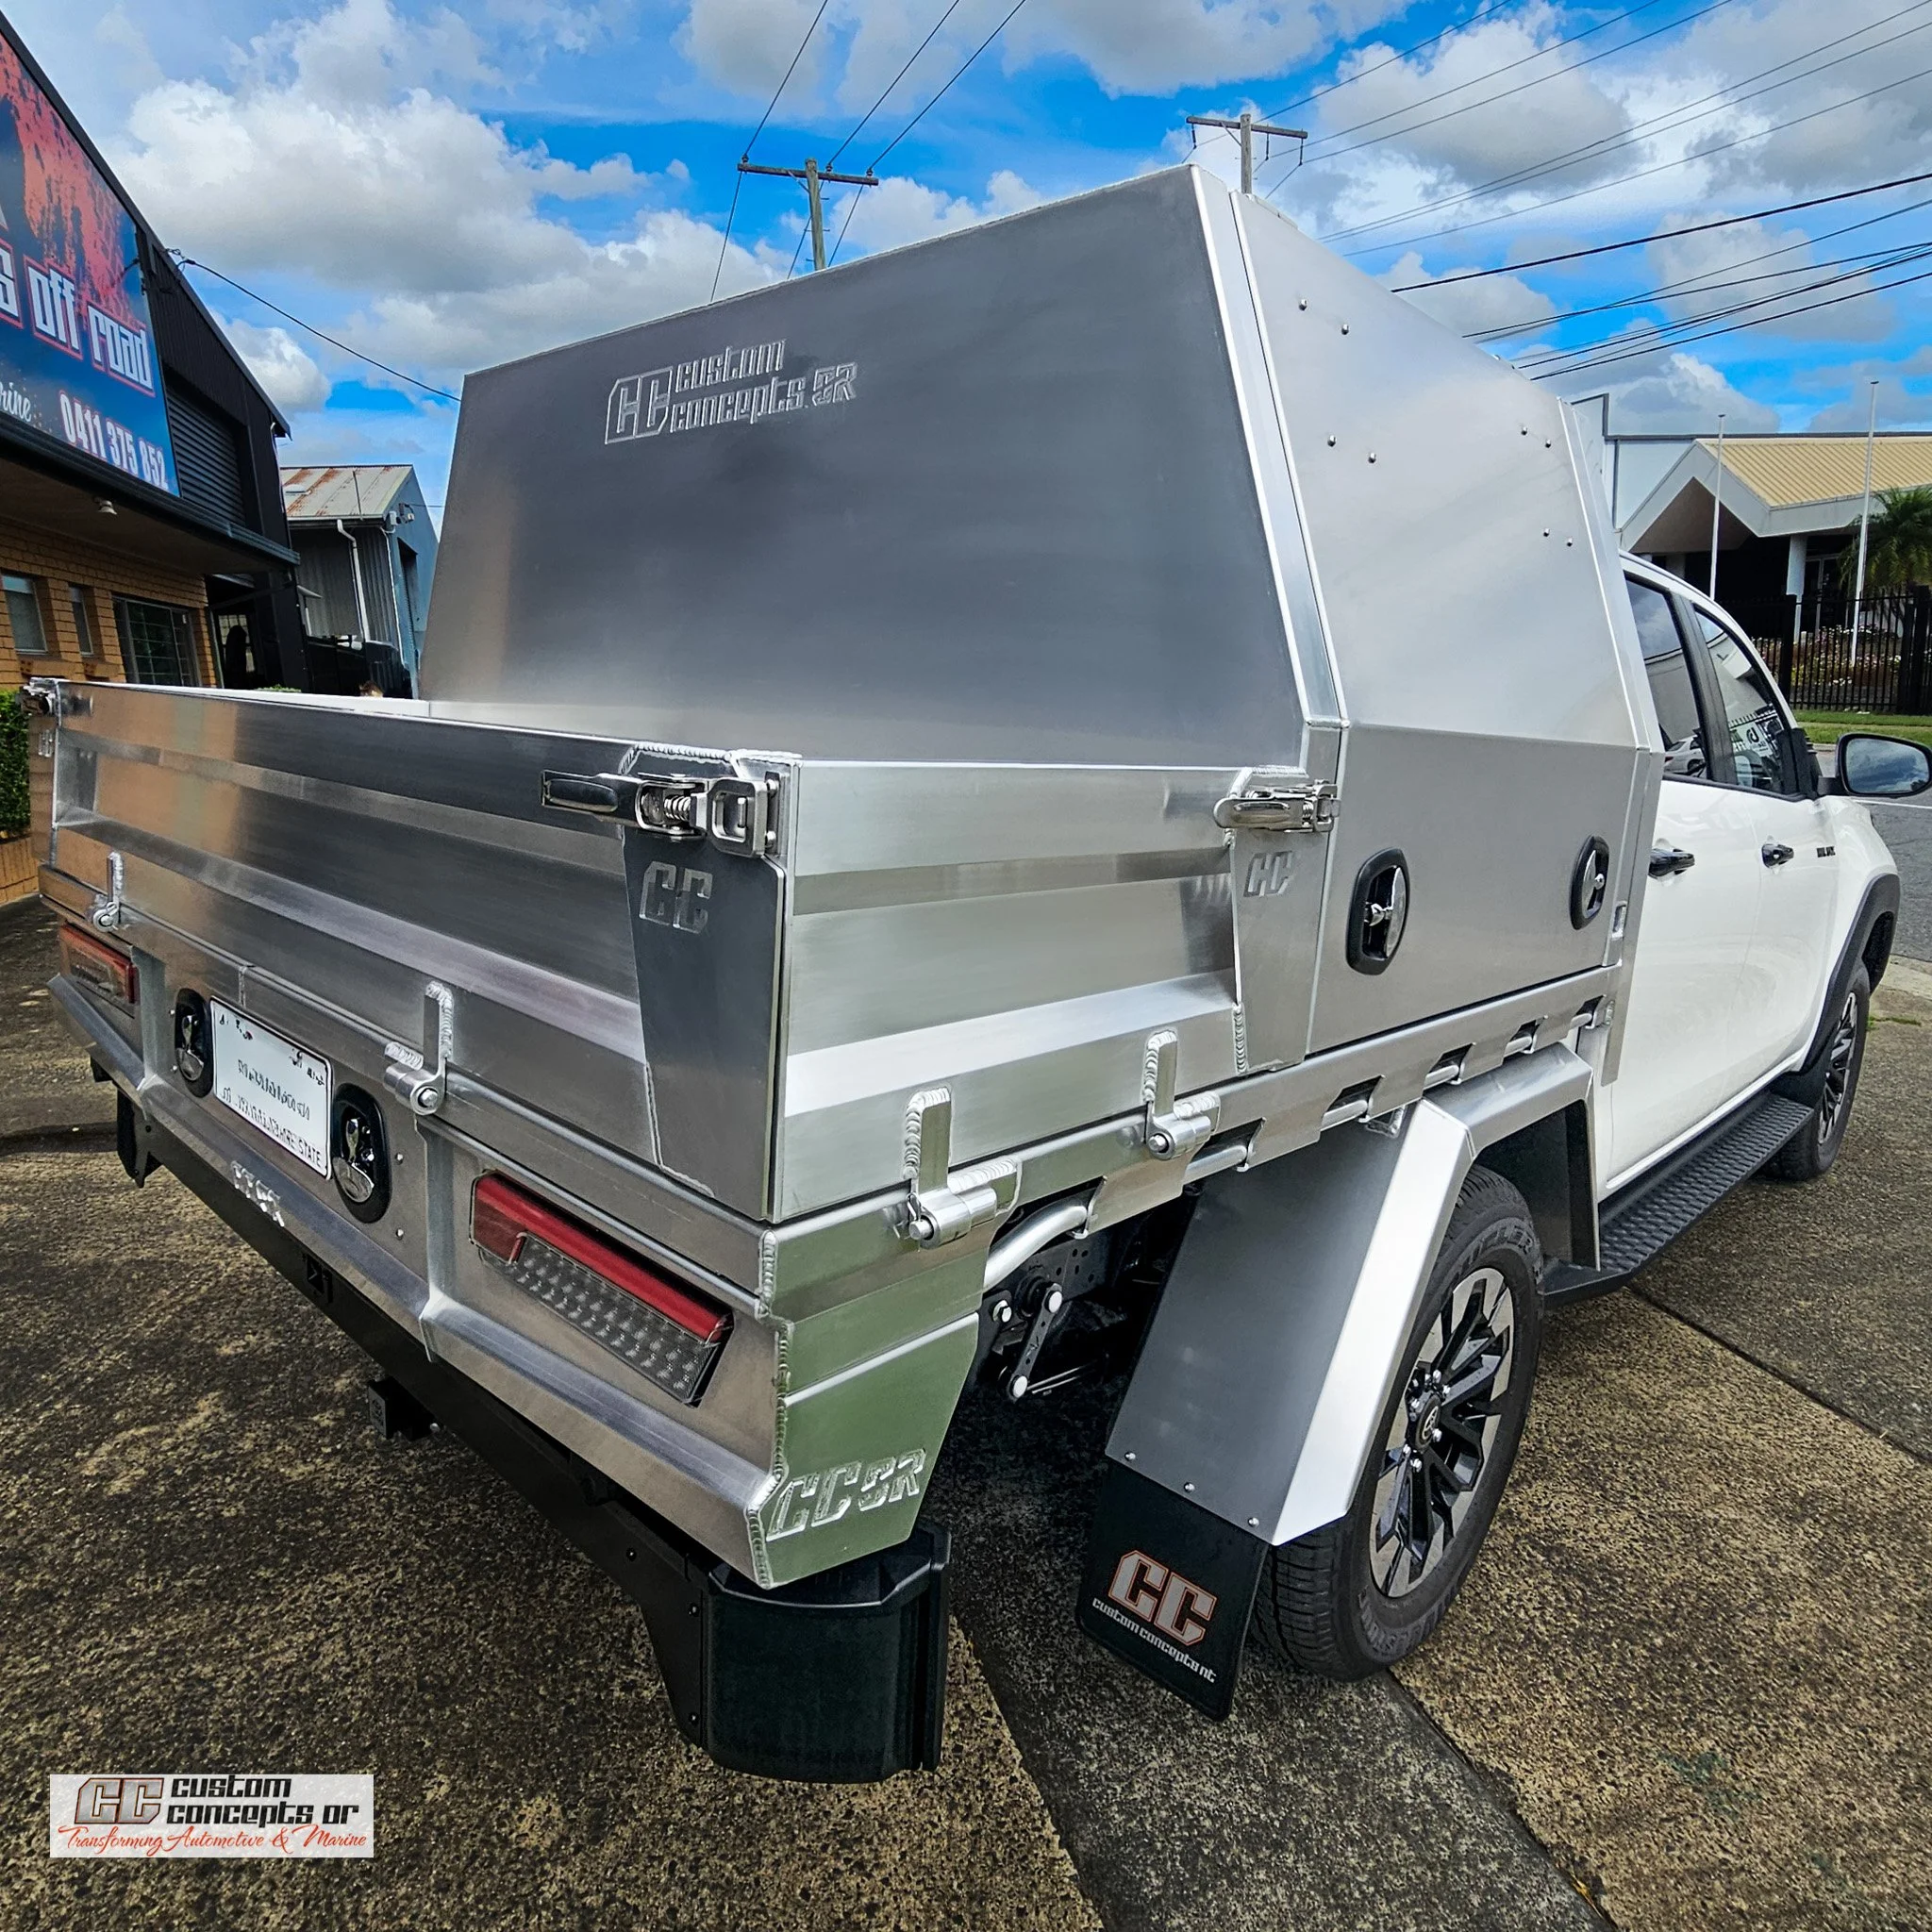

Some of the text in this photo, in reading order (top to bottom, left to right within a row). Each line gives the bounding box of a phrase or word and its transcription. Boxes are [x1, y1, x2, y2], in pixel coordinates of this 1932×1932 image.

[27, 265, 80, 351] off
[88, 305, 154, 391] road
[675, 338, 787, 392] custom
[59, 393, 107, 459] 0411
[107, 421, 139, 475] 375
[139, 440, 169, 491] 852
[1091, 1597, 1140, 1634] custom
[1139, 1627, 1200, 1674] concepts
[1108, 1549, 1218, 1646] CC
